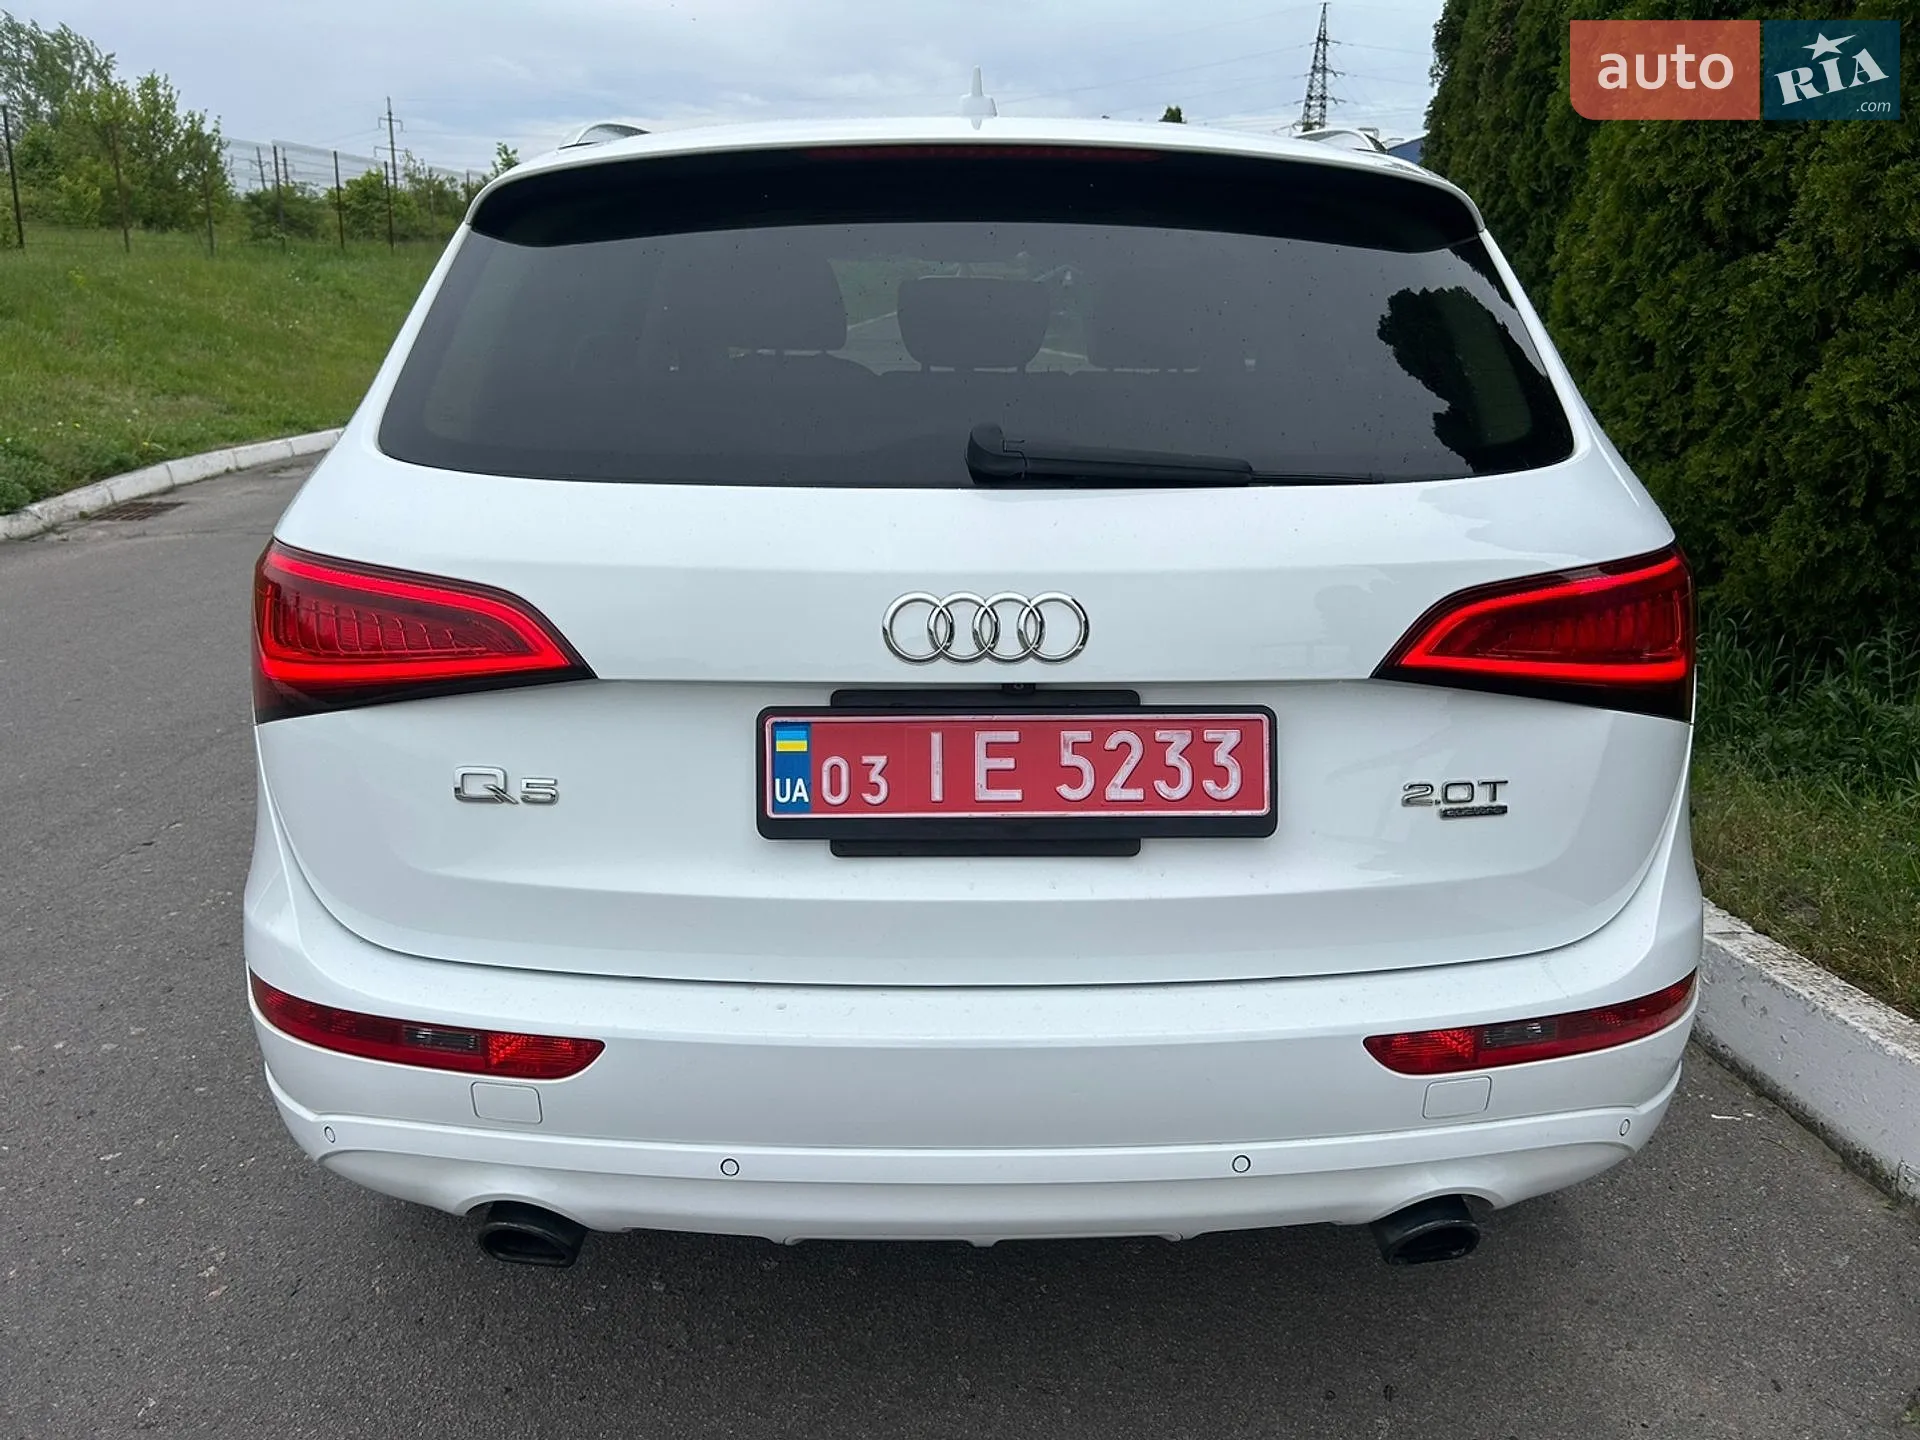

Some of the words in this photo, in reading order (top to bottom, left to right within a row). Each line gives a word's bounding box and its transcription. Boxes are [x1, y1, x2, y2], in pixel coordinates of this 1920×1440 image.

[821, 755, 889, 806] 03
[930, 731, 1023, 803] IE
[1055, 729, 1243, 803] 5233
[454, 765, 559, 805] Q5
[775, 778, 810, 804] UA
[1401, 780, 1508, 806] 2.0T
